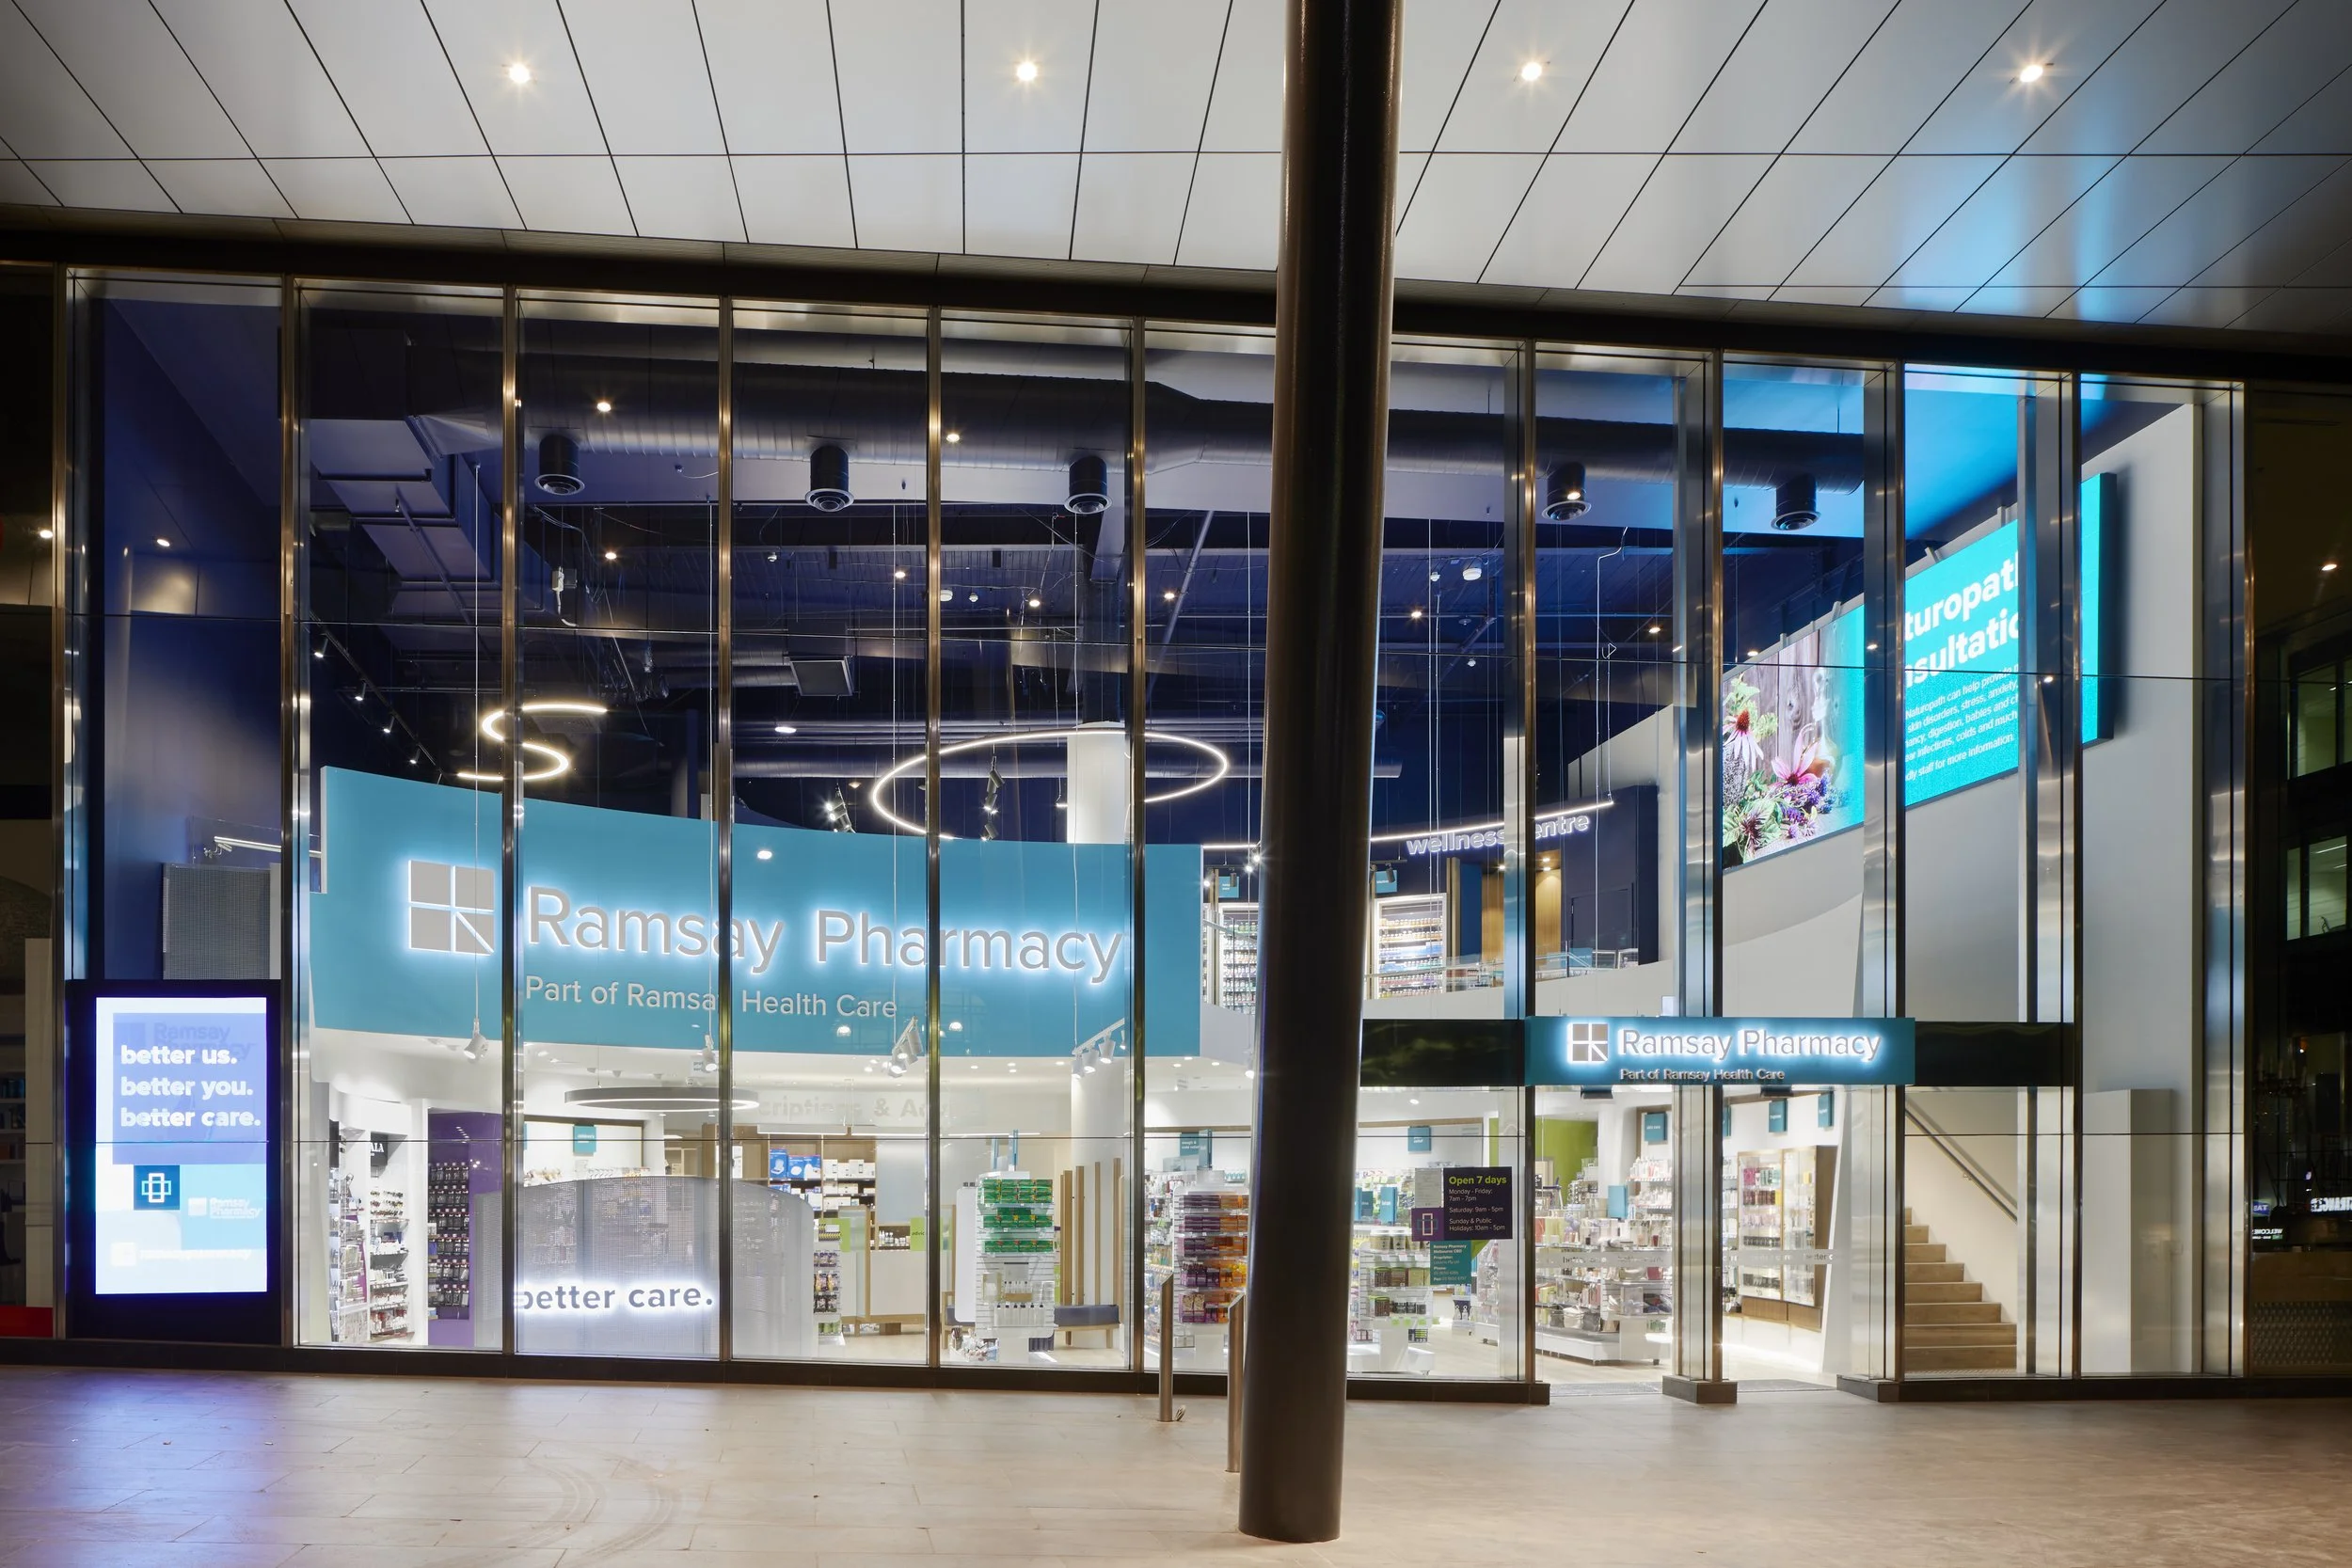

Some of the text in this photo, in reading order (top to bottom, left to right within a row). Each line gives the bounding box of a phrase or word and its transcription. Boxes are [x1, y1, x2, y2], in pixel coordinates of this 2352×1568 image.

[1947, 689, 1961, 702] can
[1963, 681, 1979, 695] help
[1965, 706, 1992, 723] babies
[1994, 698, 2010, 711] and
[1907, 721, 1922, 733] skin
[1956, 726, 1976, 741] colds
[1978, 719, 1994, 733] and
[1994, 710, 2018, 725] much
[1918, 761, 1934, 776] staff
[1935, 759, 1946, 769] for
[1947, 752, 1966, 765] more
[1406, 815, 1589, 855] wellness entre
[527, 886, 1123, 984] Ramsay Pharmacy
[526, 975, 897, 1019] Part of Ramsa Health Care
[120, 1044, 196, 1064] better
[201, 1049, 238, 1064] us.
[1618, 1029, 1881, 1063] Ramsay Pharmacy
[1620, 1069, 1785, 1082] Part of Ramsay Health Care
[120, 1076, 254, 1101] better you.
[120, 1107, 262, 1127] better care.
[1449, 1175, 1507, 1186] Open 7 days
[628, 1287, 713, 1308] care.
